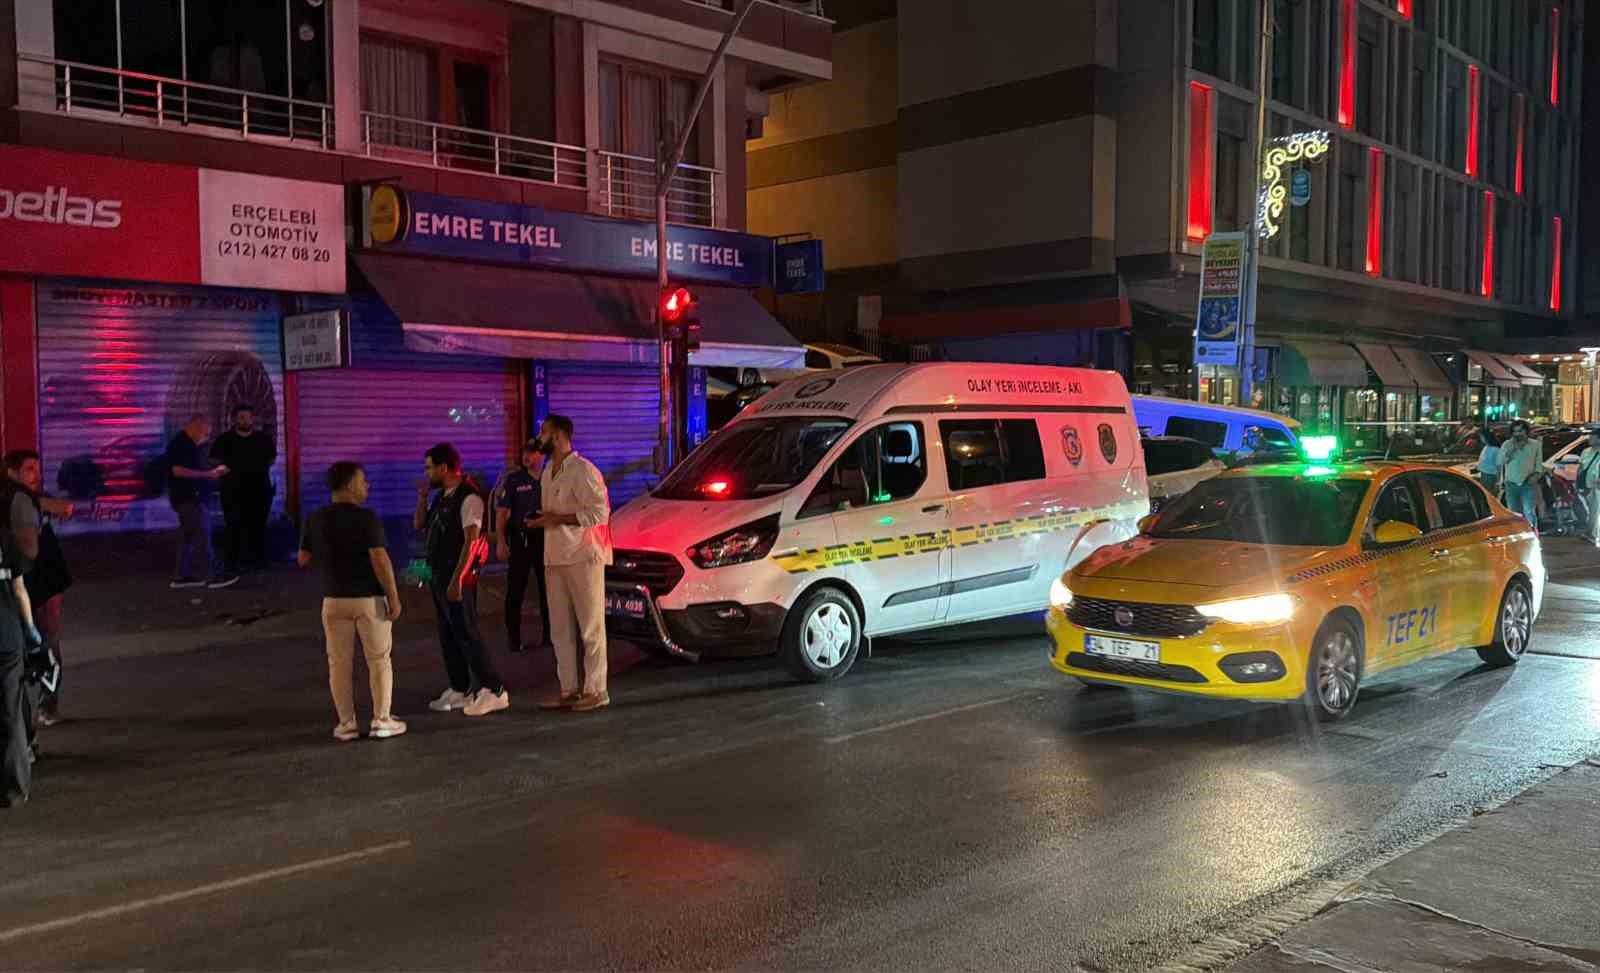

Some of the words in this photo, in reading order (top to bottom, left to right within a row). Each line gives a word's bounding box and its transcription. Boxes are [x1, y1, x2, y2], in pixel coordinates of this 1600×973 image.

[231, 203, 316, 225] ERÇELEBİ
[230, 222, 319, 243] OTOMOTİV
[415, 212, 484, 240] EMRE
[490, 220, 562, 248] TEKEL
[218, 240, 256, 259] (212)
[261, 244, 287, 259] 427
[292, 246, 309, 261] 08
[313, 248, 330, 262] 20
[688, 243, 744, 267] TEKEL
[967, 378, 992, 392] OLAY
[1386, 609, 1419, 646] TEF
[1419, 604, 1438, 638] 21
[1112, 640, 1132, 655] TEF
[1144, 644, 1157, 659] 21
